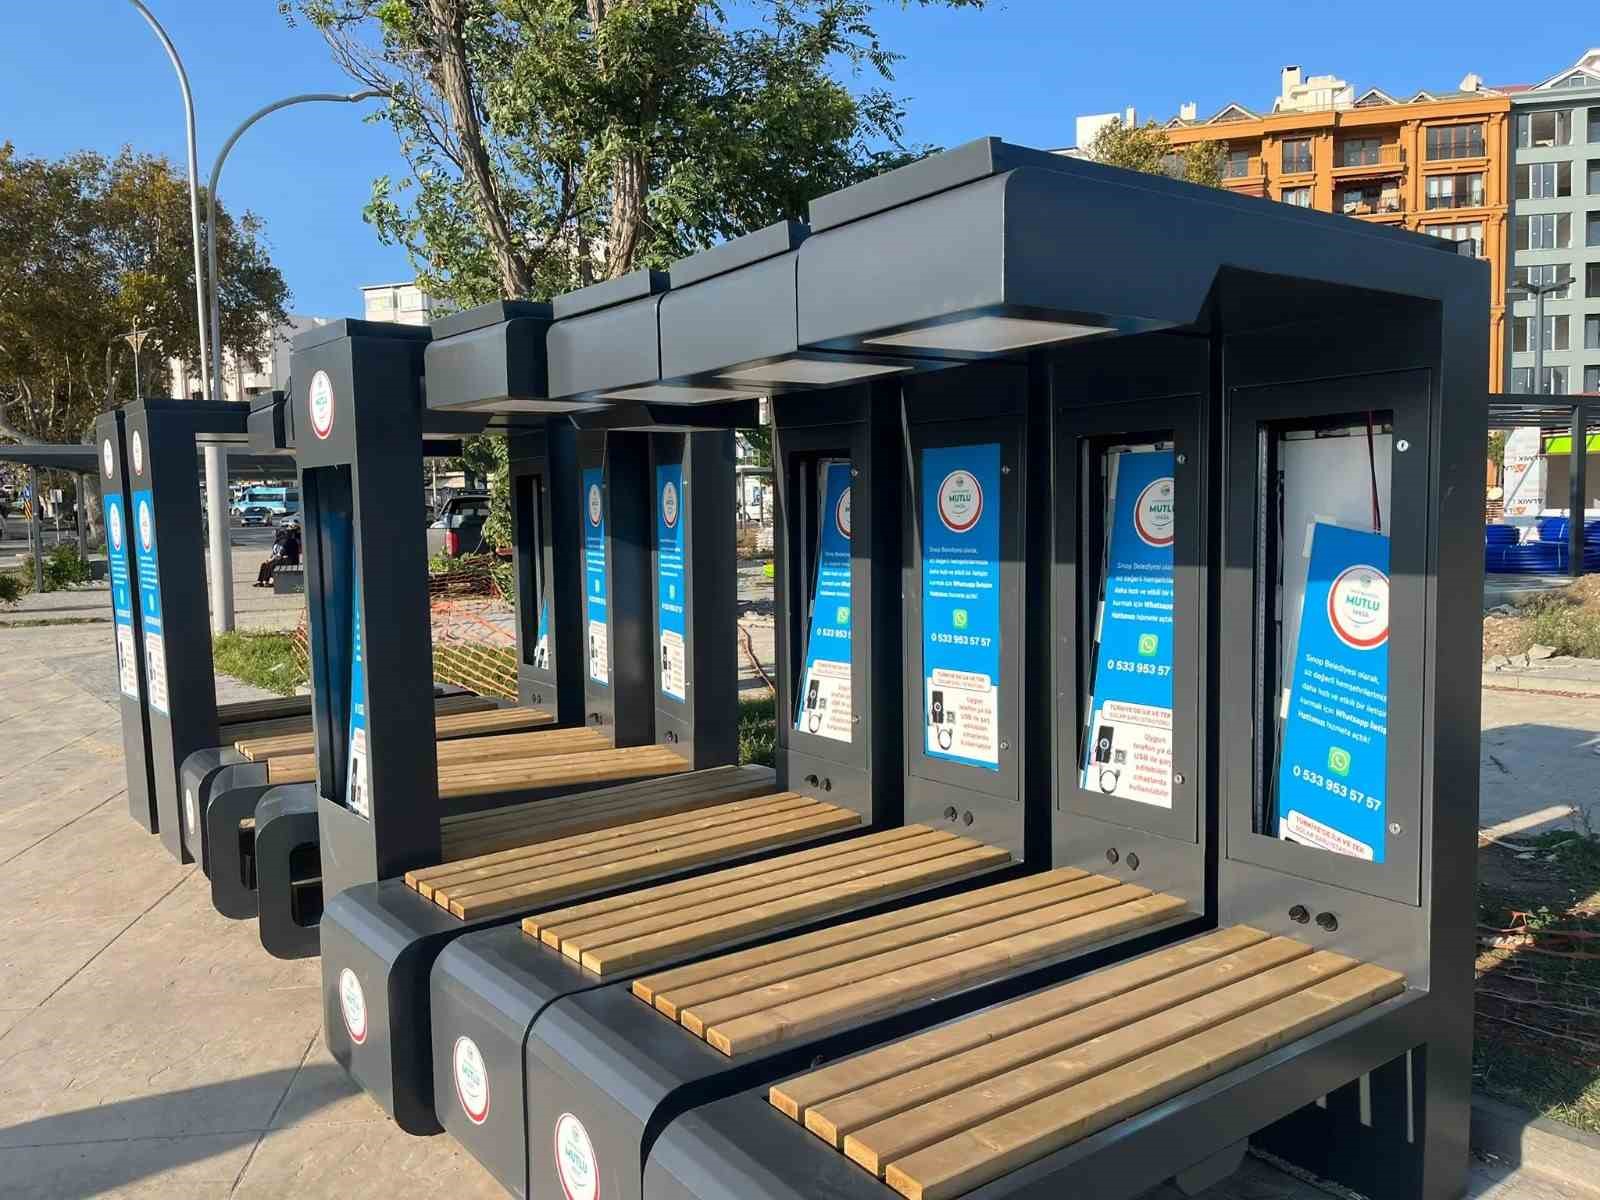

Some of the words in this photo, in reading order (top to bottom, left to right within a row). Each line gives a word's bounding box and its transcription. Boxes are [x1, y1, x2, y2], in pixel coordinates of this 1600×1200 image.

[1345, 594, 1380, 611] MUTLU
[931, 633, 937, 642] 0
[938, 633, 952, 643] 533
[953, 634, 968, 645] 953
[969, 636, 979, 646] 57
[981, 638, 991, 647] 57
[1107, 659, 1114, 670] 0
[1116, 660, 1135, 672] 533
[1137, 662, 1156, 673] 953
[1158, 664, 1170, 676] 57
[1293, 765, 1301, 777] 0
[1302, 769, 1323, 787] 533
[1326, 779, 1348, 797] 953
[1349, 788, 1364, 804] 57
[1366, 796, 1382, 811] 57
